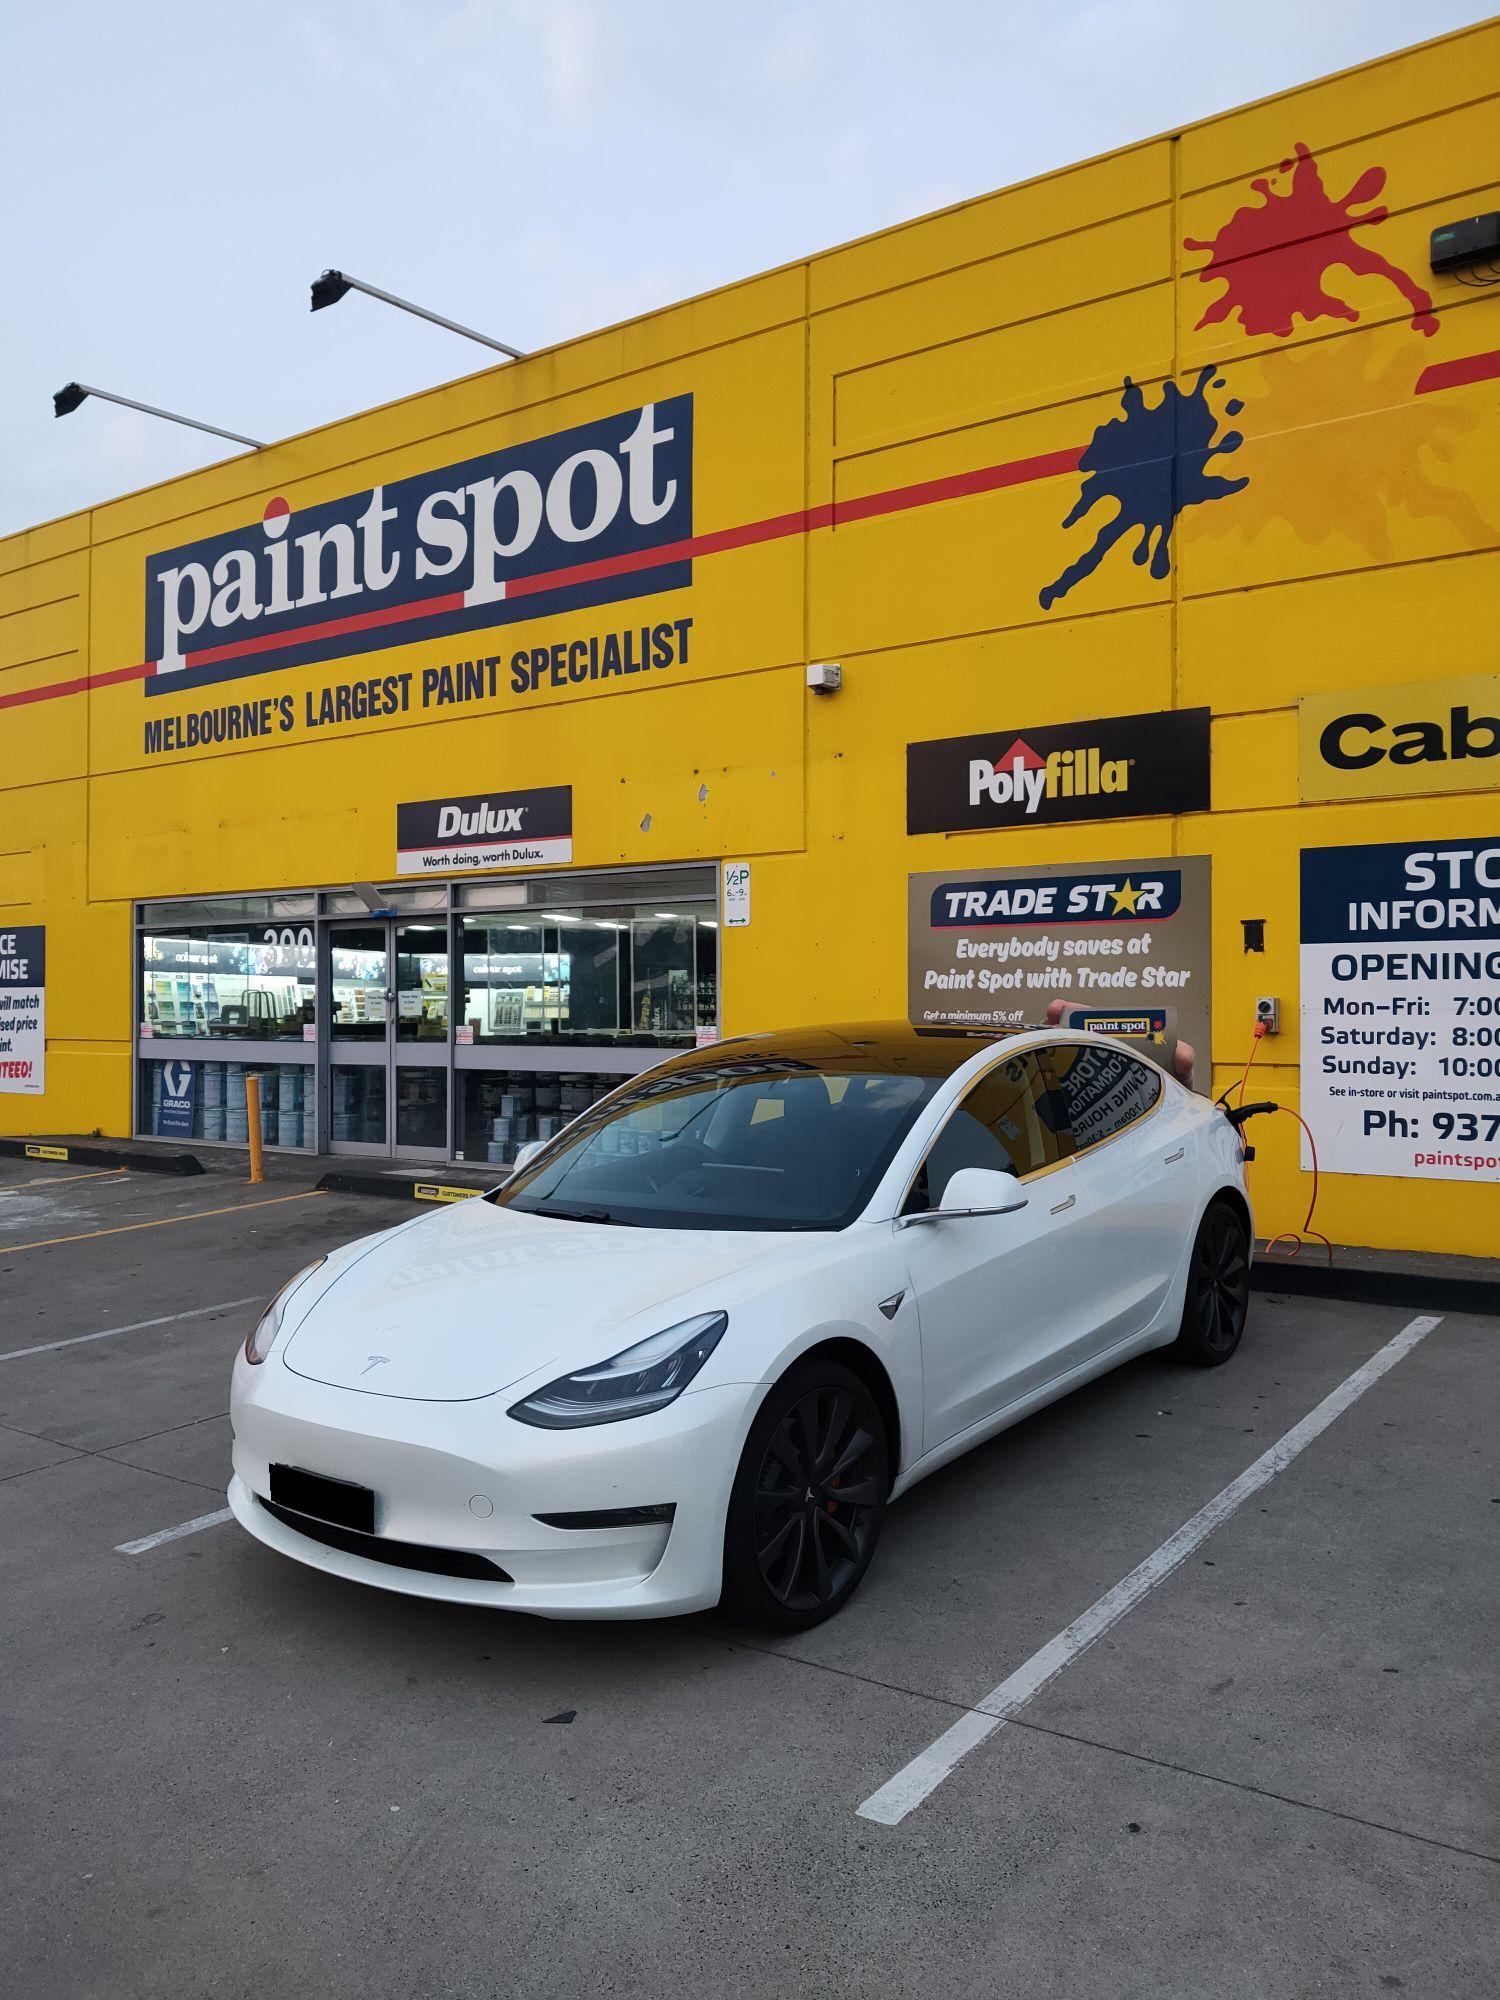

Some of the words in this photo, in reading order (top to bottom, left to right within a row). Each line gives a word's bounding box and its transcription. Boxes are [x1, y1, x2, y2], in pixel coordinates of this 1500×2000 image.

[157, 487, 400, 674] paint
[416, 404, 677, 607] spot
[144, 695, 294, 755] MELBOURNE'S
[306, 672, 413, 727] LARGEST
[422, 656, 500, 708] PAINT
[511, 617, 693, 694] SPECIALIST
[1319, 706, 1500, 770] Cab
[969, 748, 1129, 813] Polyfilla
[437, 803, 524, 838] Dulux
[423, 853, 450, 867] Worth
[452, 852, 481, 866] doing,
[482, 851, 510, 862] worth
[512, 848, 543, 861] Dulux.
[1404, 849, 1500, 891] STO
[945, 887, 1057, 917] TRADE
[1067, 879, 1164, 916] STR
[956, 936, 1059, 962] Everybody
[1063, 938, 1123, 956] saves
[1127, 933, 1151, 954] at
[924, 968, 975, 989] Paint
[978, 968, 1023, 994] Spot
[1026, 967, 1072, 988] with
[1077, 967, 1136, 988] Trade
[1141, 966, 1191, 988] Star
[12, 994, 39, 1009] match
[16, 1014, 37, 1034] price
[924, 1010, 939, 1020] Get
[948, 1010, 991, 1020] minimum
[993, 1010, 1006, 1021] 5%
[1008, 1010, 1024, 1021] off
[1089, 1021, 1119, 1031] paint
[1121, 1021, 1145, 1032] spot
[1321, 1026, 1436, 1050] Saturday:
[0, 1061, 32, 1078] TEED!
[1322, 1055, 1416, 1079] Sunday:
[163, 1100, 190, 1108] GRACO
[1330, 1086, 1346, 1096] See
[1349, 1087, 1384, 1097] in-store
[1387, 1089, 1397, 1098] or
[1400, 1088, 1420, 1099] visit
[1364, 1110, 1419, 1138] Ph:
[1433, 1112, 1500, 1141] 937
